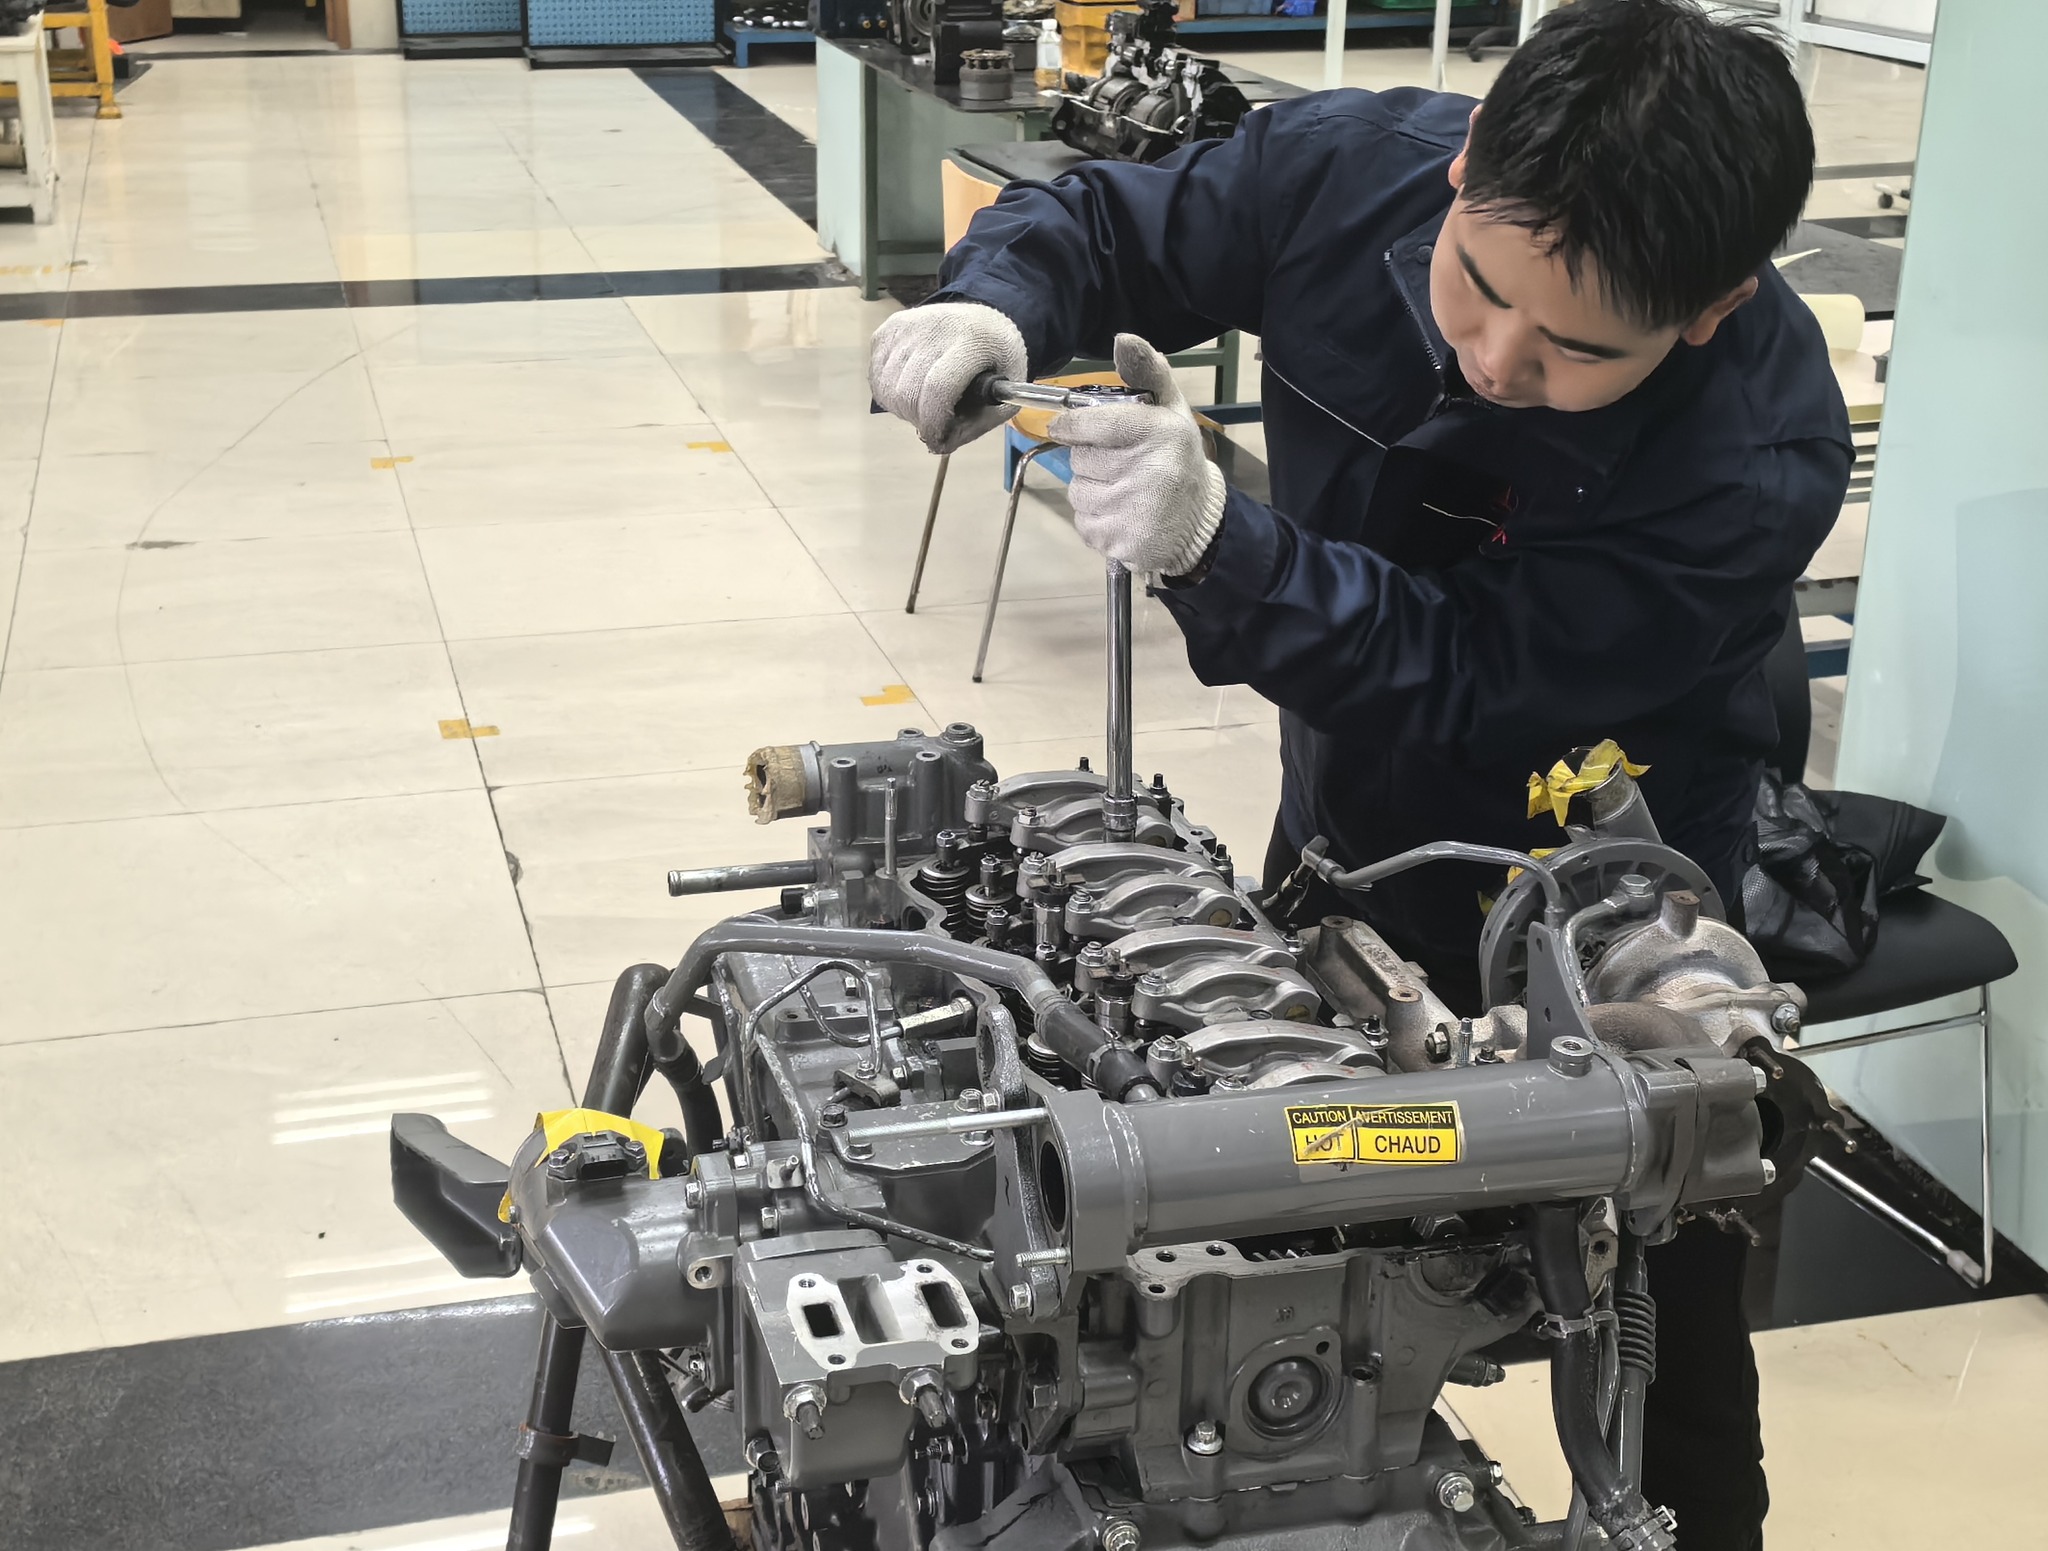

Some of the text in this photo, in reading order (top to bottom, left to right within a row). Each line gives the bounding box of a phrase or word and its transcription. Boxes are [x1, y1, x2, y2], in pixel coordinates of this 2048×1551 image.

[1292, 1110, 1347, 1124] CAUTION
[1355, 1110, 1452, 1124] AVERTISSEMENT
[1305, 1133, 1344, 1152] HOT
[1375, 1135, 1441, 1154] CHAUD
